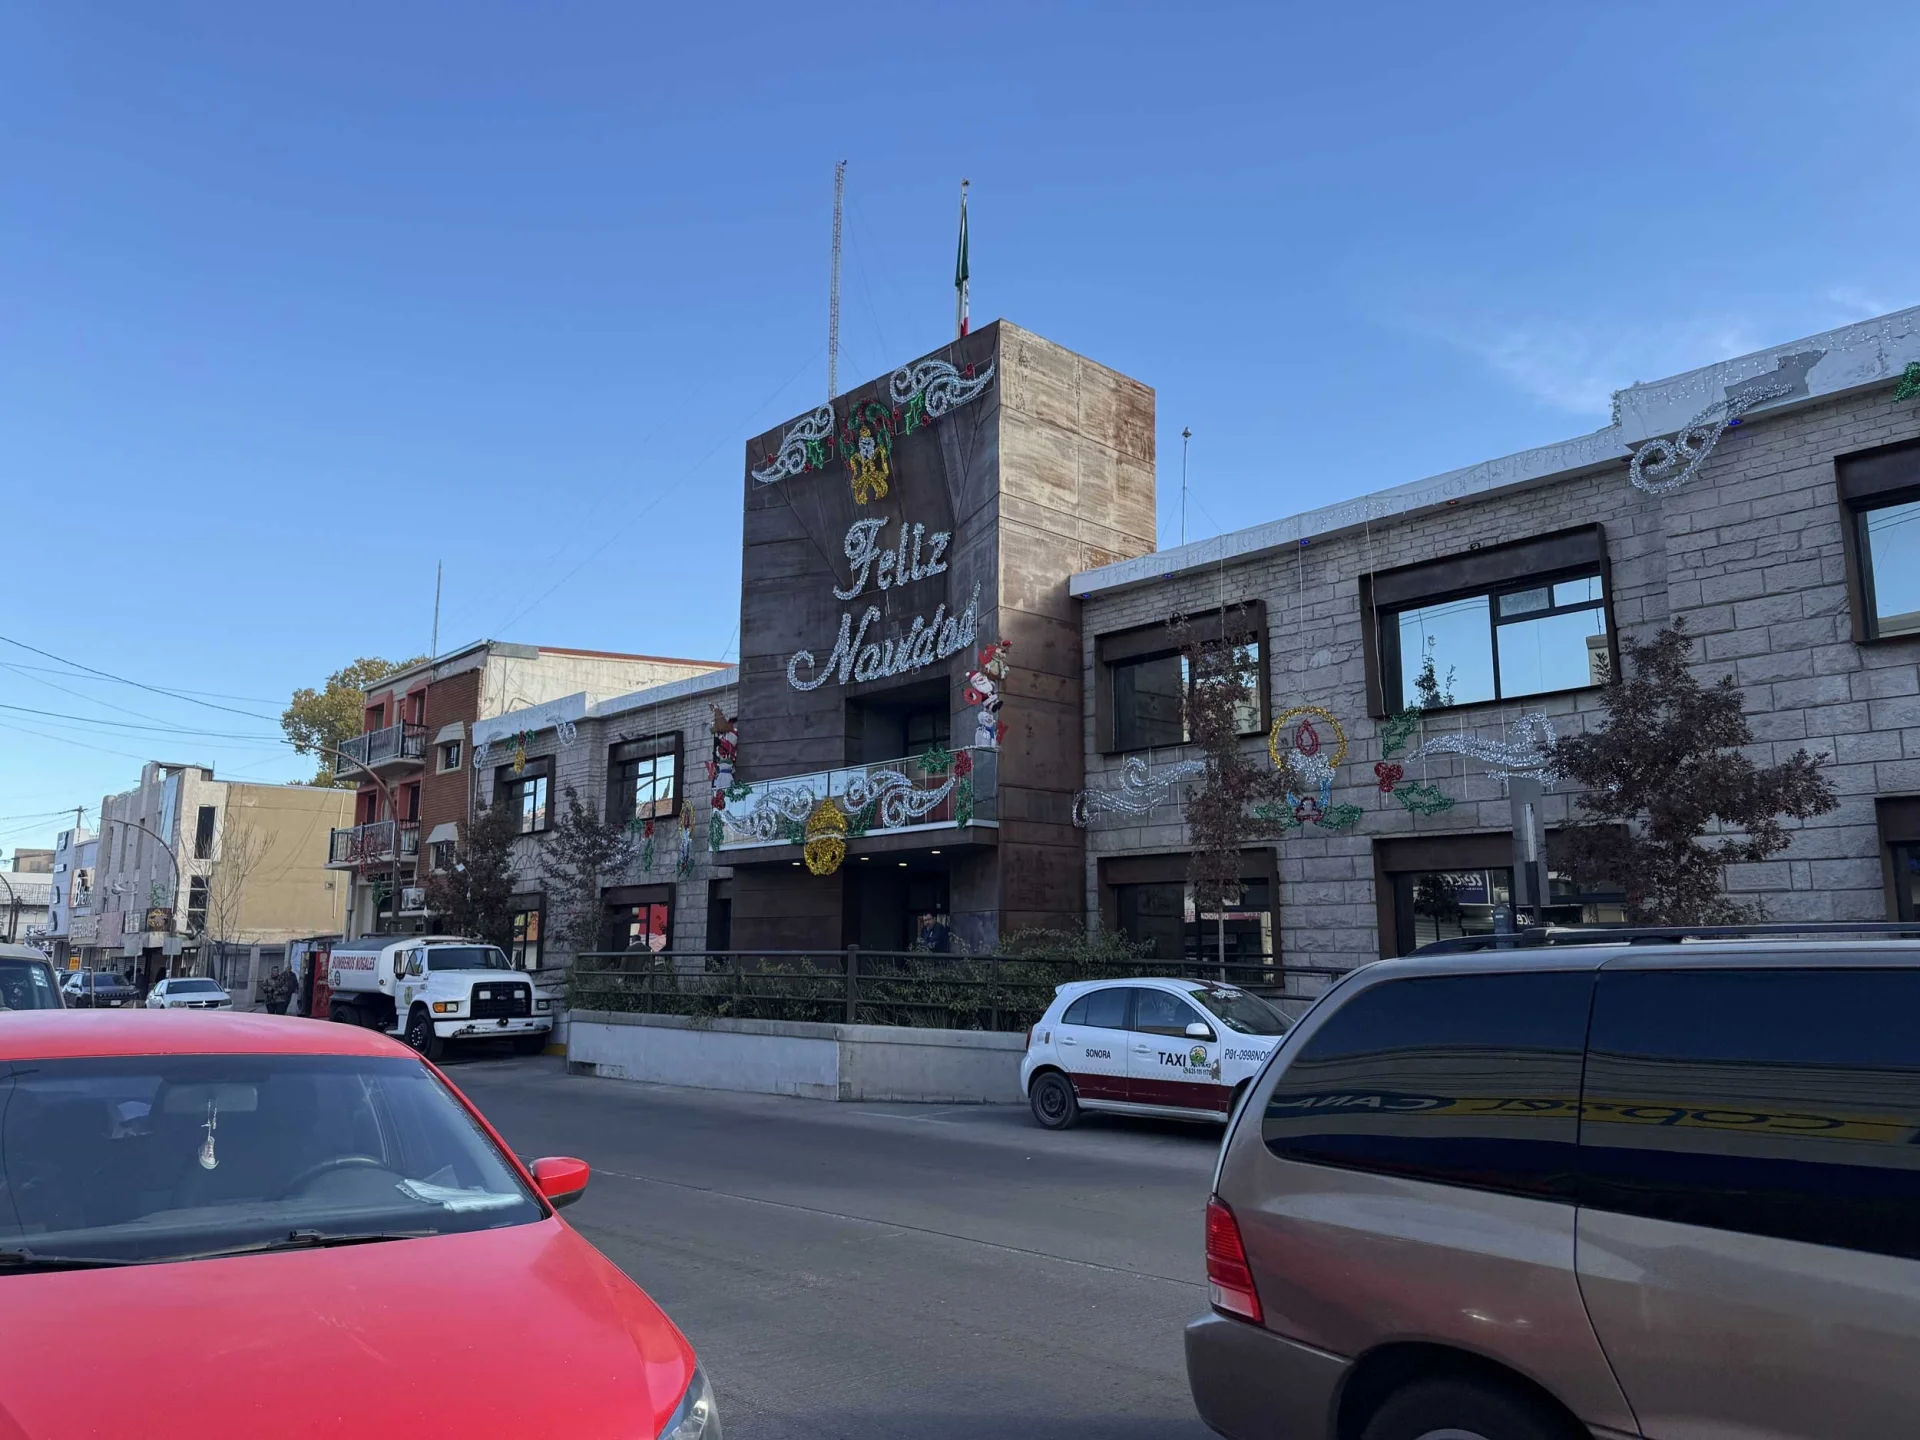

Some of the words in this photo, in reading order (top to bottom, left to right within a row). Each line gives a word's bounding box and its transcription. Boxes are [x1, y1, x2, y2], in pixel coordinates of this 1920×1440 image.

[833, 516, 952, 601] Feliz
[787, 580, 981, 691] Navidad
[331, 955, 356, 970] BOMBEROS
[355, 956, 376, 971] NOGALES
[1085, 1048, 1111, 1060] SONORA
[1158, 1051, 1187, 1067] TAXI
